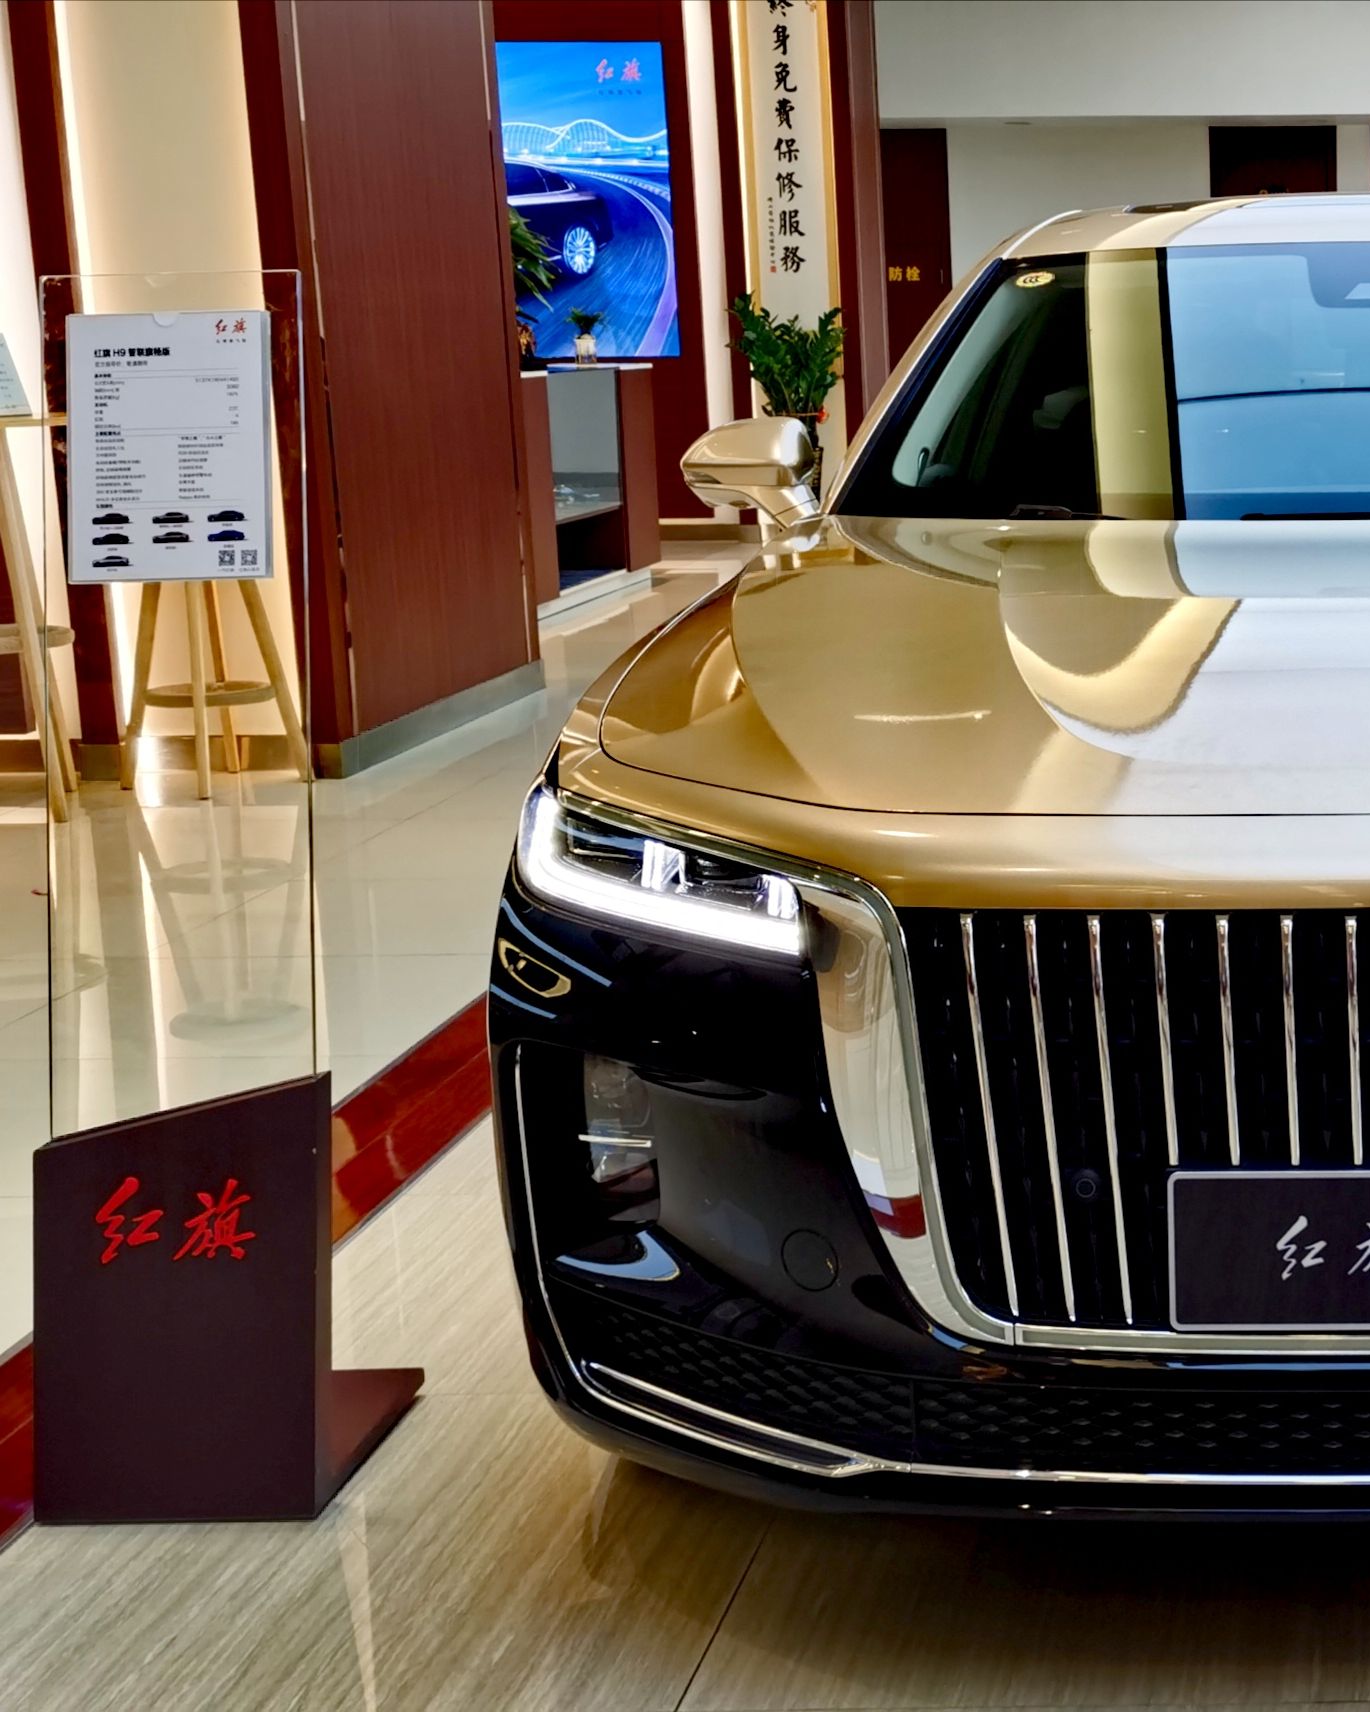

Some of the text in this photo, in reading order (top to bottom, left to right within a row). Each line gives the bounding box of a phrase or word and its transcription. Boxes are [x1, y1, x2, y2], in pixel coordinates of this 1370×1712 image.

[595, 57, 642, 83] 红旗
[215, 318, 247, 335] 红旗
[113, 348, 126, 357] H9
[96, 1177, 256, 1264] 红旗
